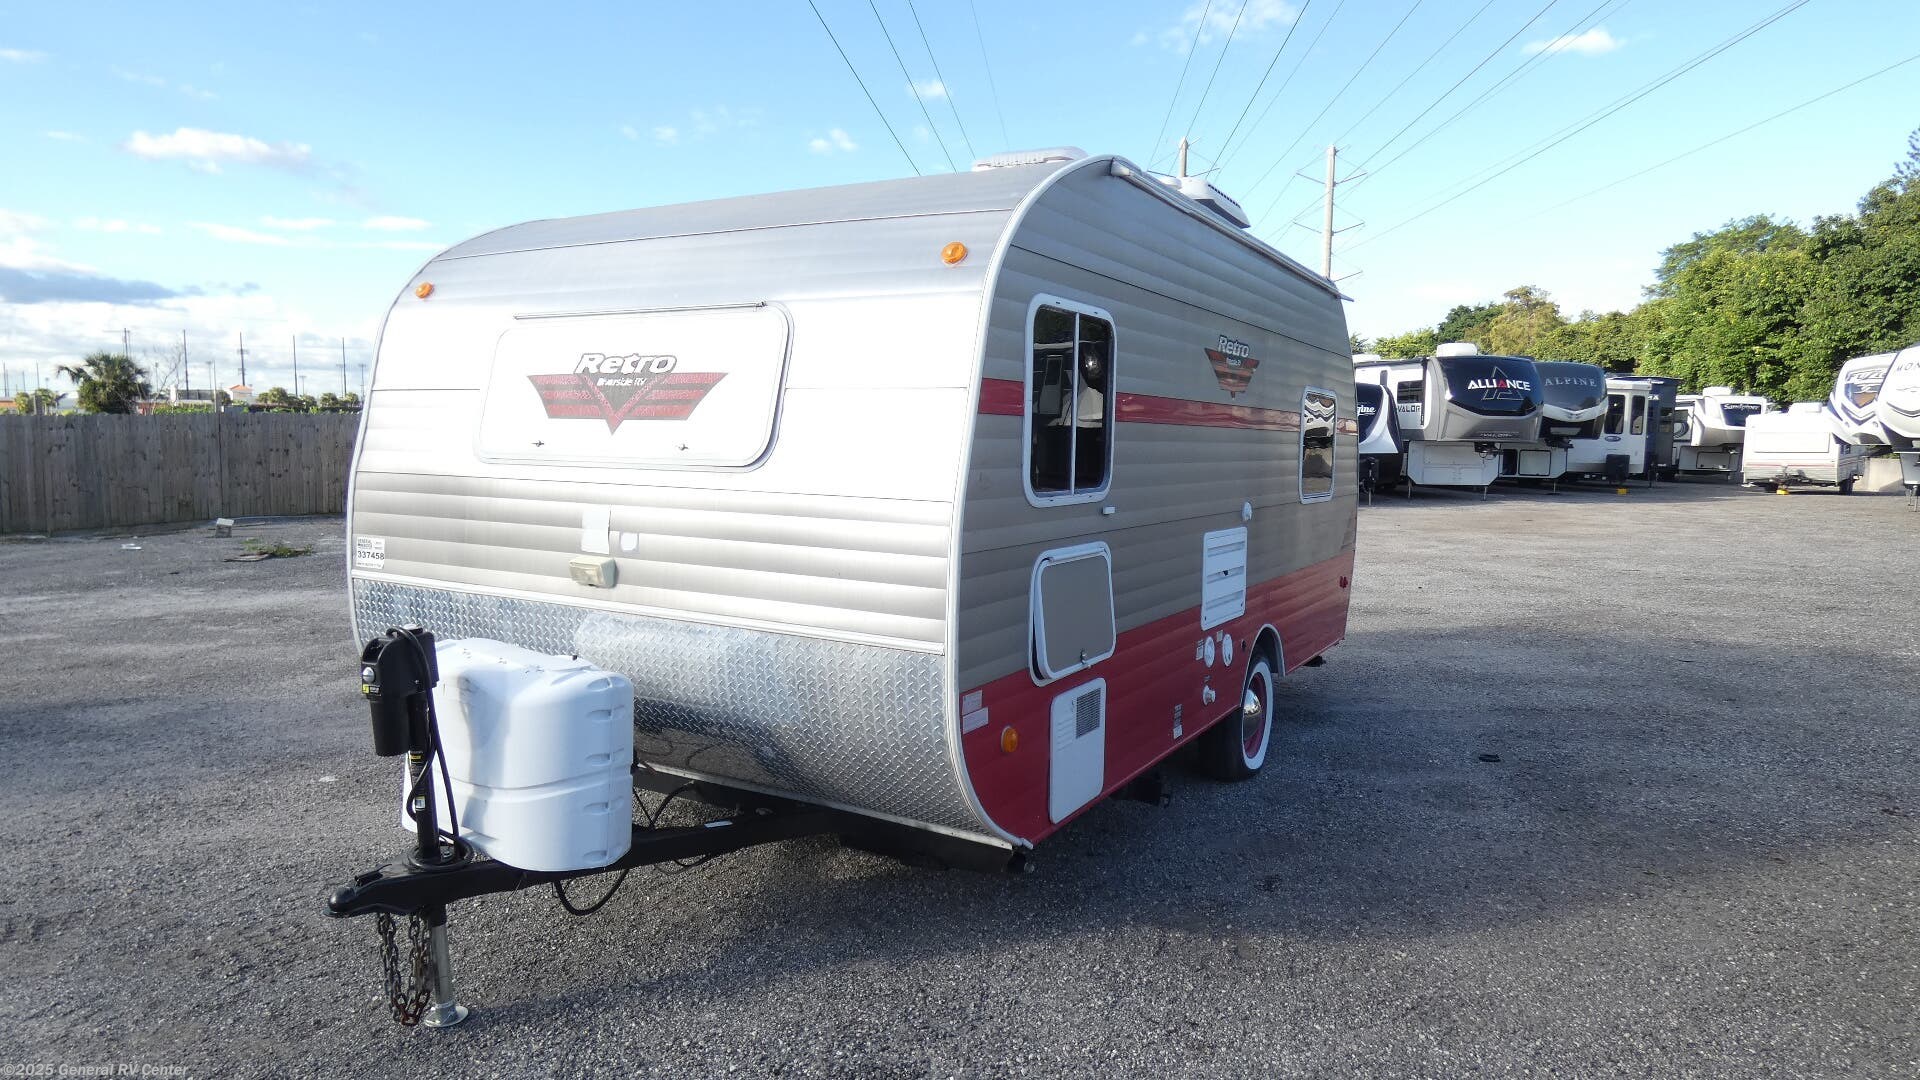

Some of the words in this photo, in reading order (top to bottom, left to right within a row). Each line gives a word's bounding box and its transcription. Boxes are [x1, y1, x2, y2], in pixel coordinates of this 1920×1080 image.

[1217, 335, 1250, 358] Retro
[573, 353, 677, 374] Retro
[1467, 378, 1531, 391] ALLIANCE
[1544, 377, 1597, 387] ALPINE
[357, 550, 385, 560] 337458
